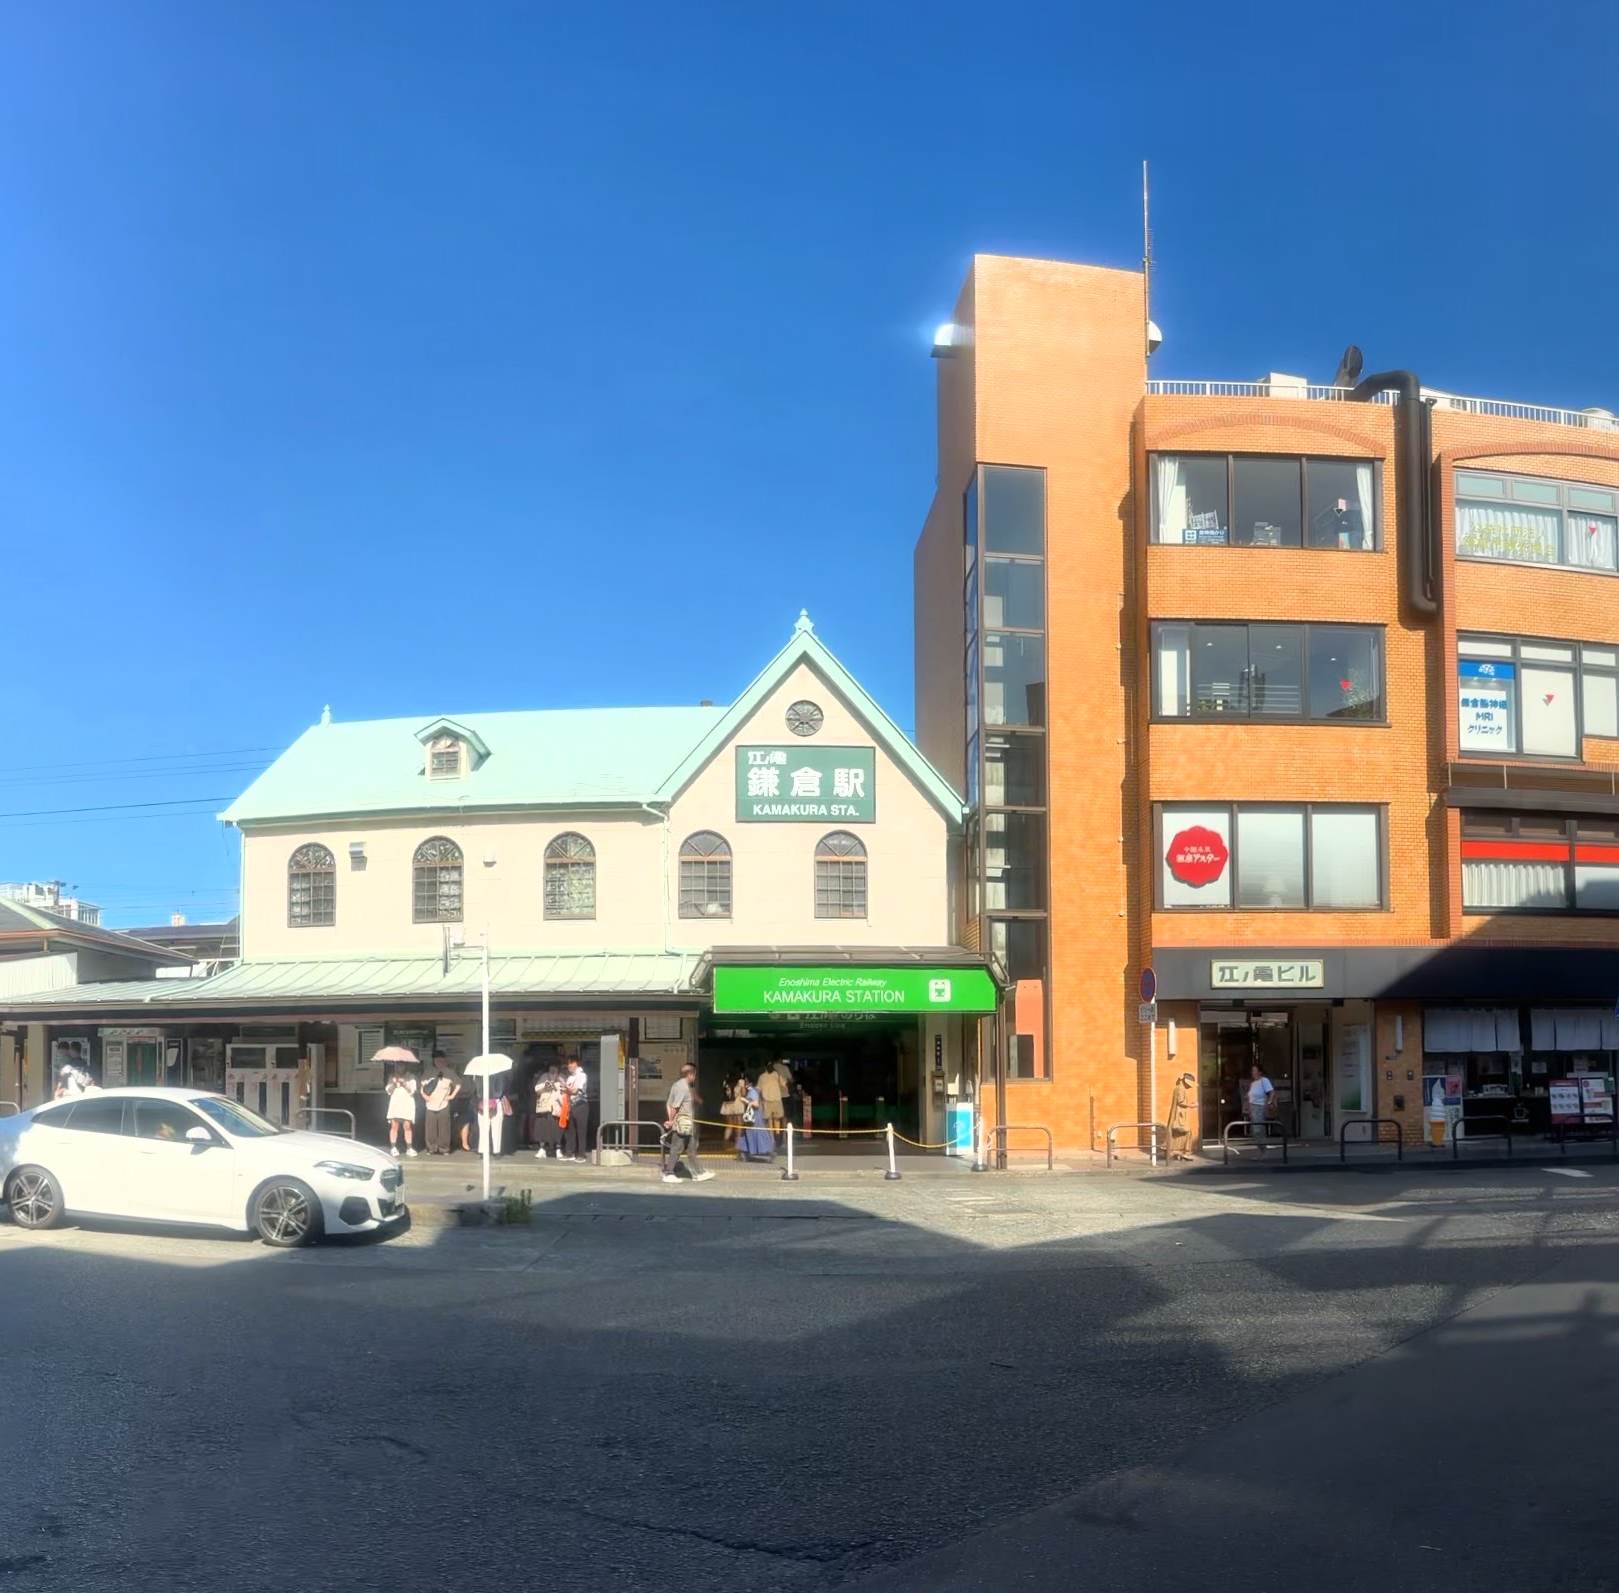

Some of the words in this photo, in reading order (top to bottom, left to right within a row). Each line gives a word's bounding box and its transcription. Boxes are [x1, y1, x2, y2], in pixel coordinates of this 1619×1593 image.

[1475, 712, 1494, 722] MRI
[1467, 724, 1502, 735] クリニック
[747, 767, 865, 798] 鎌倉駅
[753, 804, 828, 816] KAMAKURA
[831, 804, 859, 816] STA.
[1219, 965, 1316, 983] 江ノ電ビル
[779, 978, 820, 987] Enoshima
[822, 978, 854, 987] Electric
[855, 978, 887, 988] Railway
[763, 990, 840, 1003] KAMAKURA
[846, 990, 905, 1003] STATION
